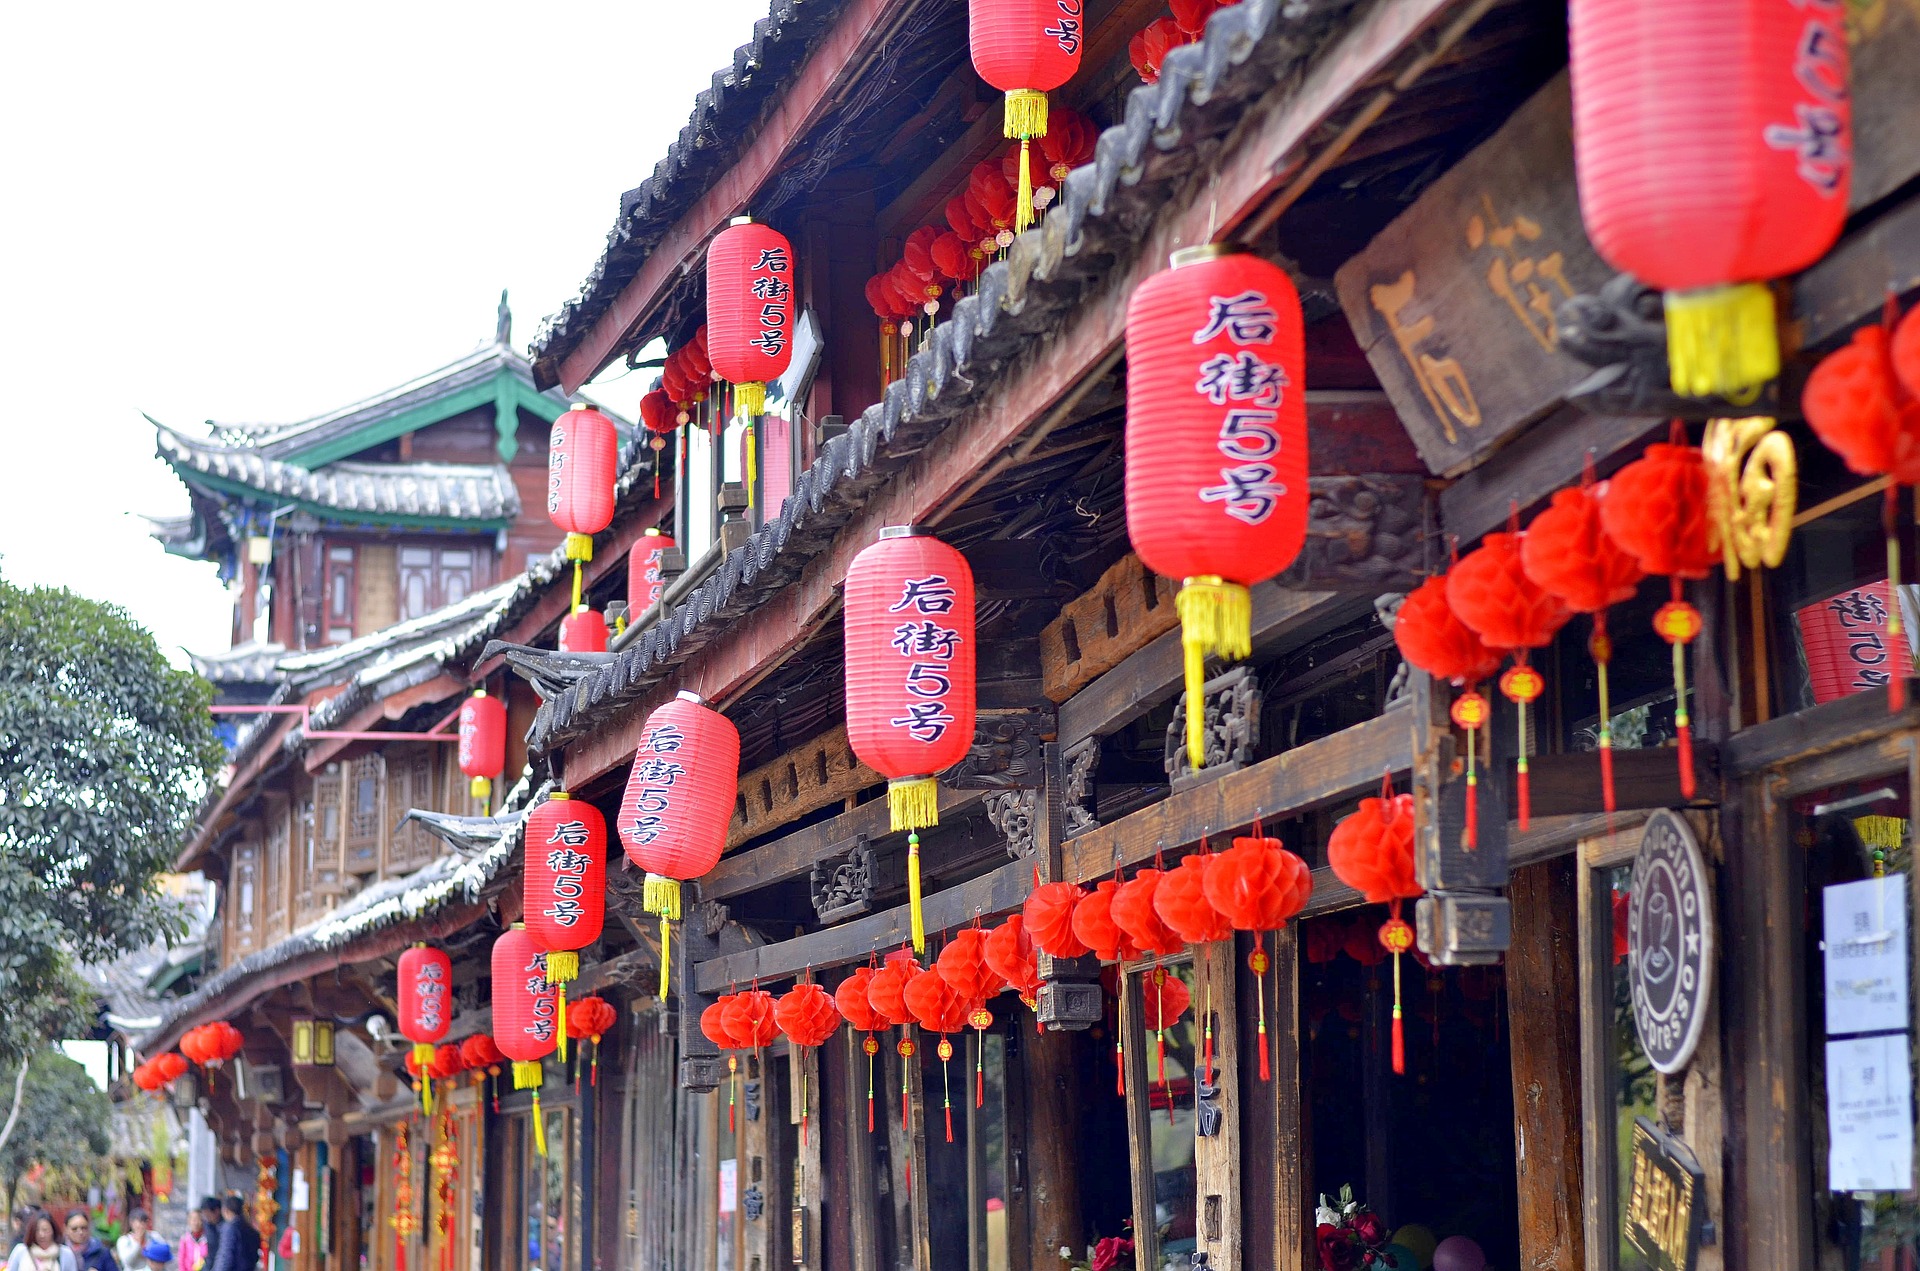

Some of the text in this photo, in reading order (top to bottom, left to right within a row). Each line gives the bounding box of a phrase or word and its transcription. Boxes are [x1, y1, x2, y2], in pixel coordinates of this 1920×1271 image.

[1762, 0, 1850, 197] 5号
[751, 247, 791, 356] 后街5号
[1192, 290, 1290, 525] 后街5号
[889, 575, 963, 743] 后街5号
[622, 724, 686, 846] 后街5号
[544, 820, 593, 927] 后街5号
[414, 961, 445, 1032] 后街5号
[524, 952, 559, 1042] 后街5号
[973, 1011, 988, 1025] 福
[1635, 964, 1694, 1051] espresso
